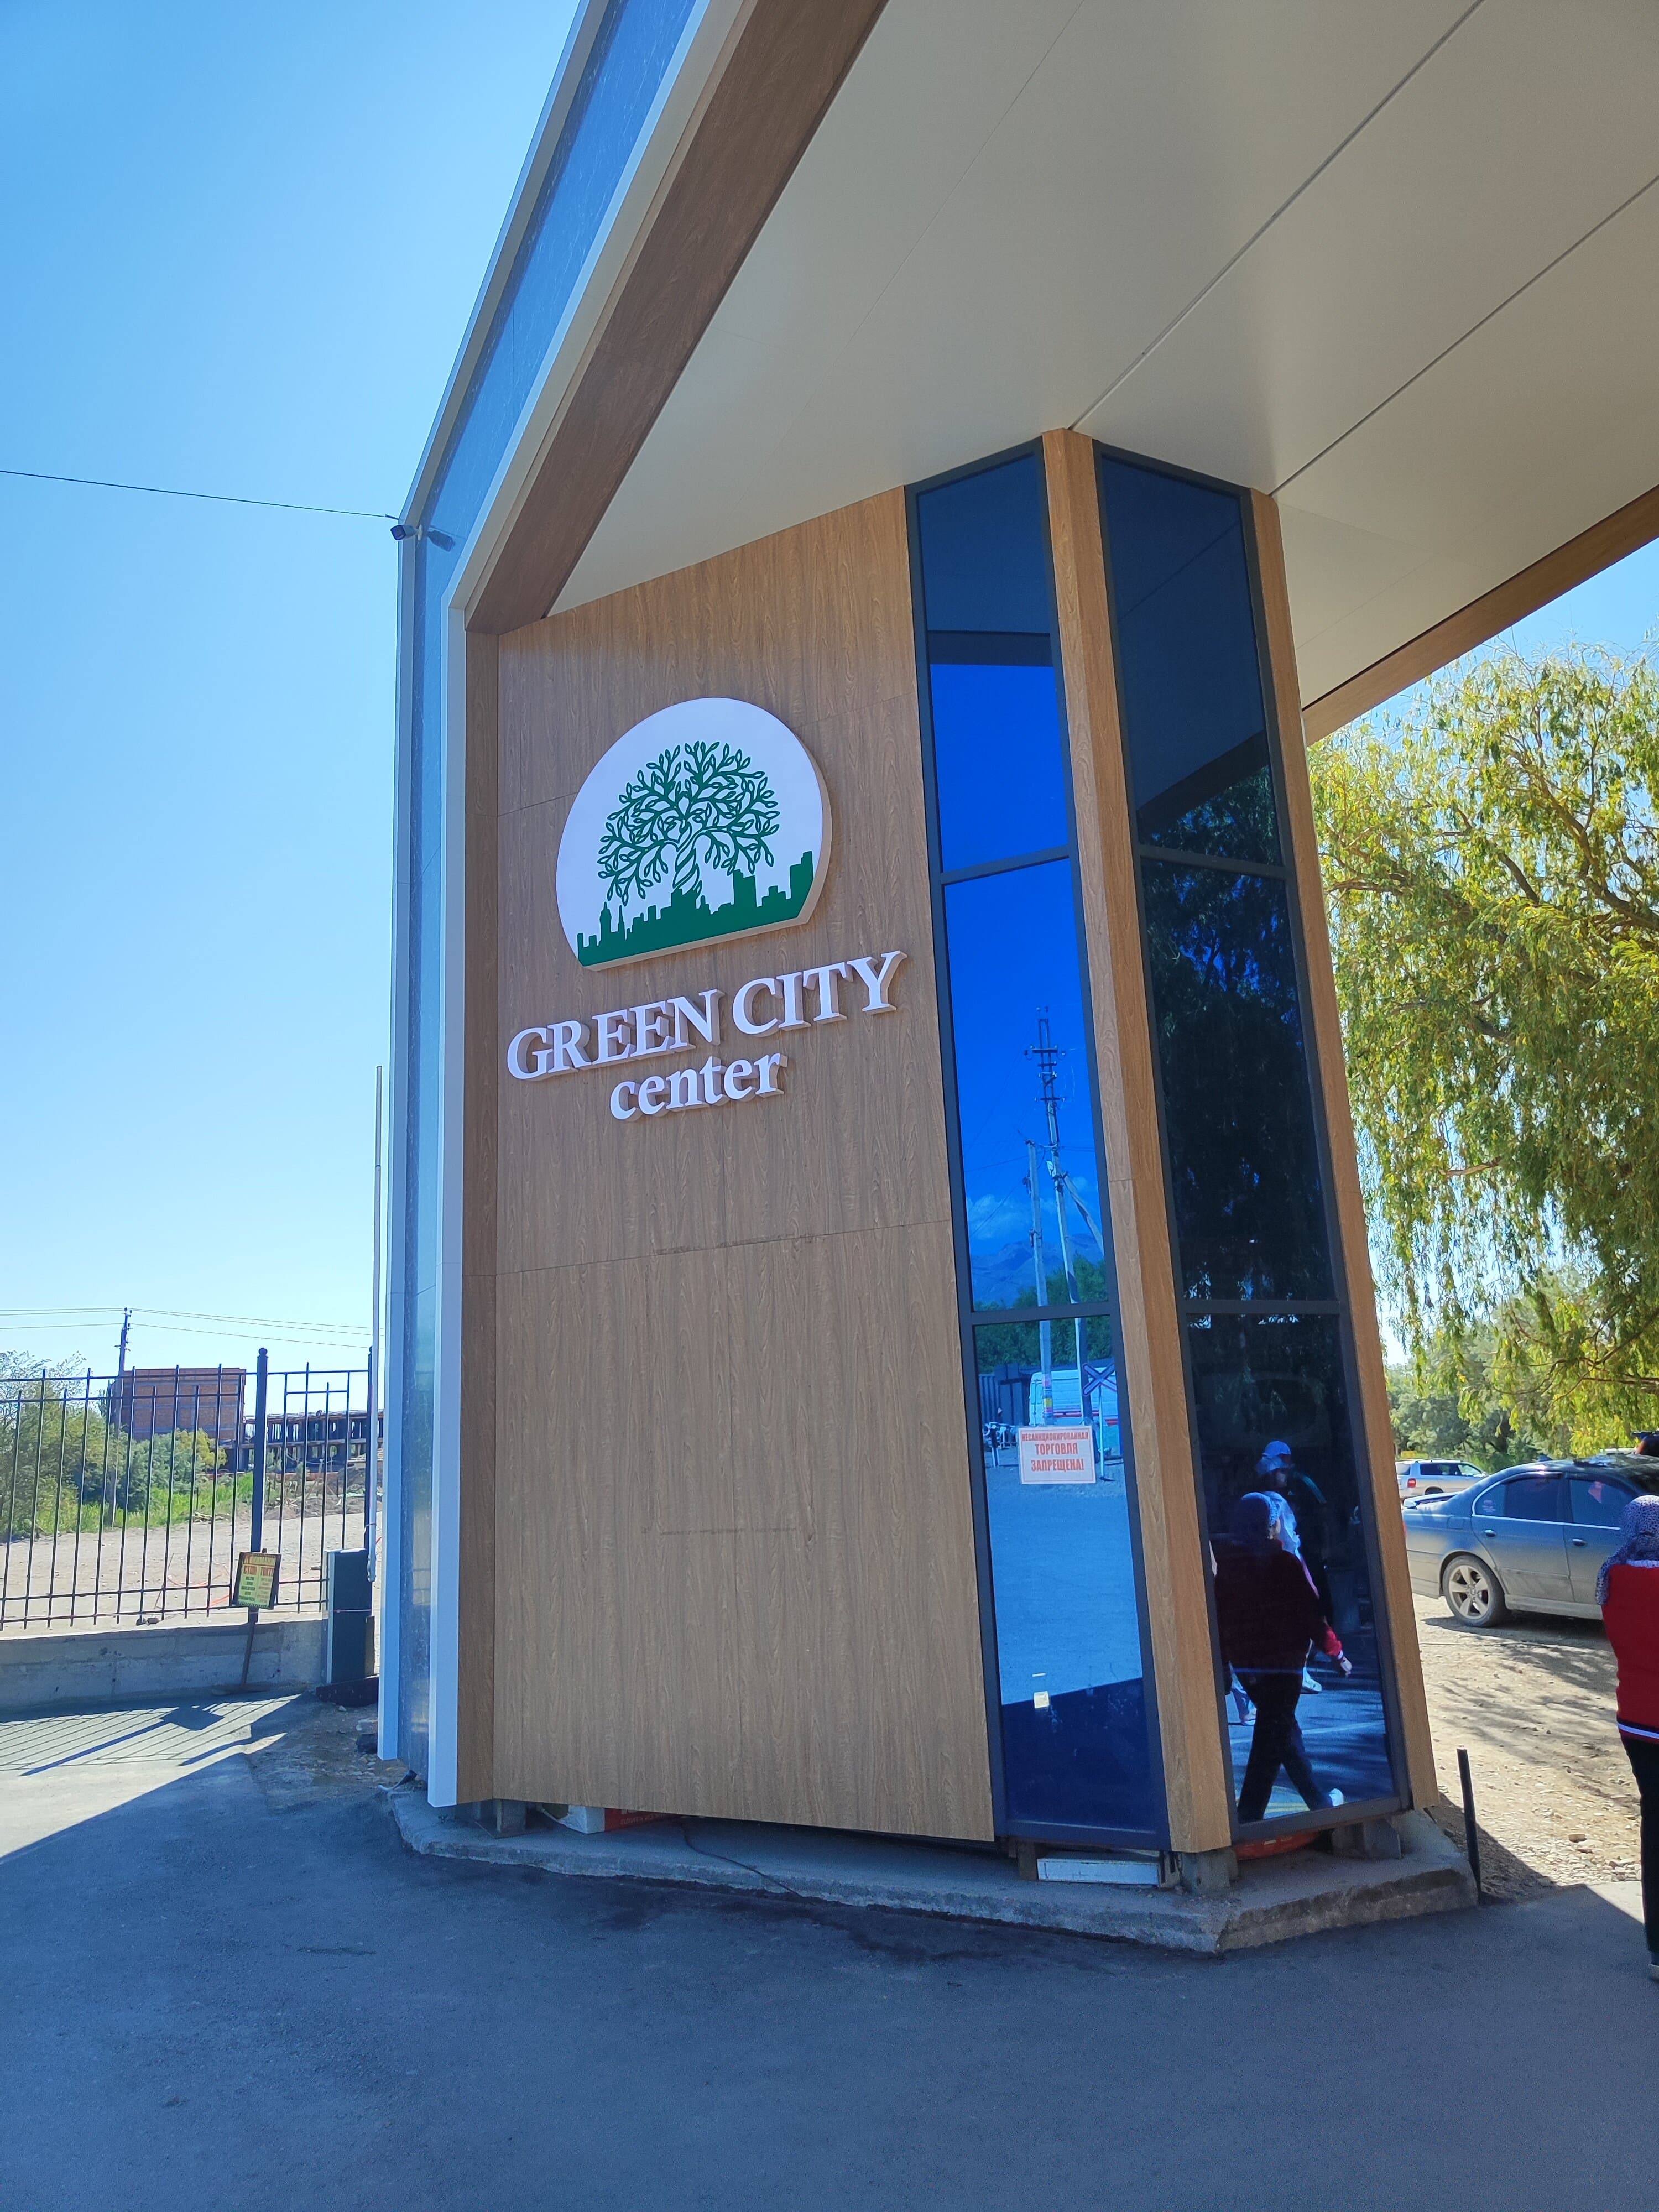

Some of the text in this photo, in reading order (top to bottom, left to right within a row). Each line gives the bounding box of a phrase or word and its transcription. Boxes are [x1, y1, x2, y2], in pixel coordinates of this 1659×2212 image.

[507, 950, 907, 1081] GREEN CITY
[610, 1052, 787, 1121] center
[1031, 1458, 1084, 1472] ЗАПРЕЩЕНА!
[1035, 1443, 1078, 1455] ТОРГОВЛЯ
